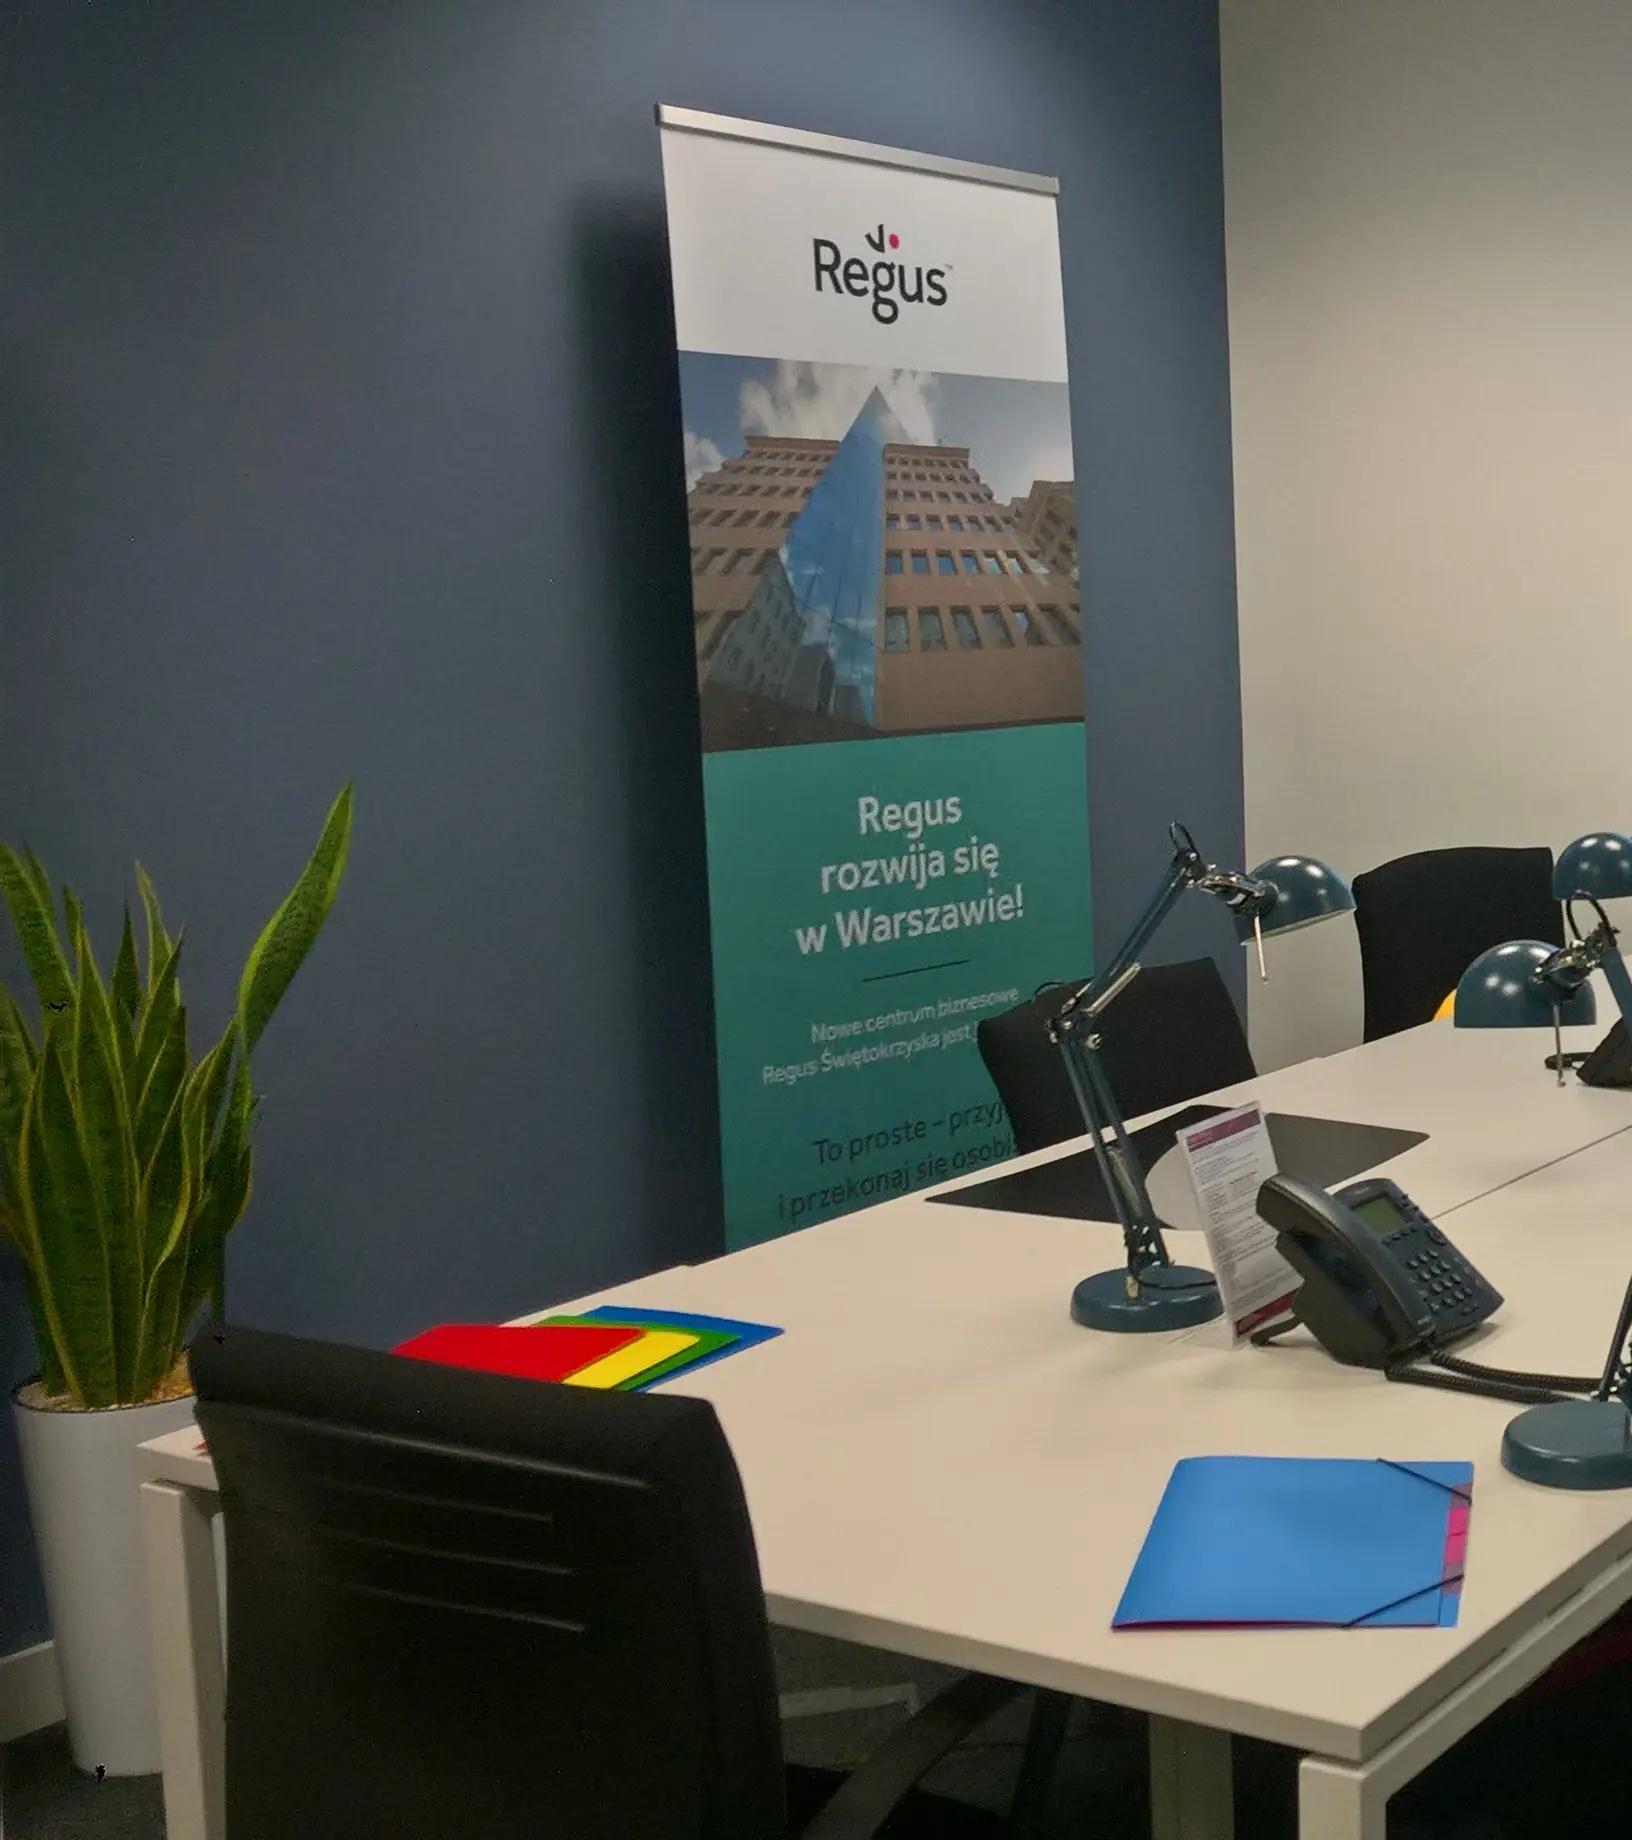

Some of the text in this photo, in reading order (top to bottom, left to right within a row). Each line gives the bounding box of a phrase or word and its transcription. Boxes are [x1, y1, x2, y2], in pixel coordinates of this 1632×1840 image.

[812, 237, 949, 325] Regus
[857, 795, 963, 839] Regus
[820, 836, 1000, 892] rozwija się
[795, 884, 1025, 955] w Warszawie!
[810, 988, 1019, 1044] Nowe centrum biznesowe
[762, 1059, 819, 1086] Regus
[820, 1033, 941, 1072] Świętokrzyska
[811, 1138, 842, 1166] To
[848, 1120, 927, 1161] proste
[787, 1164, 911, 1218] przekonaj
